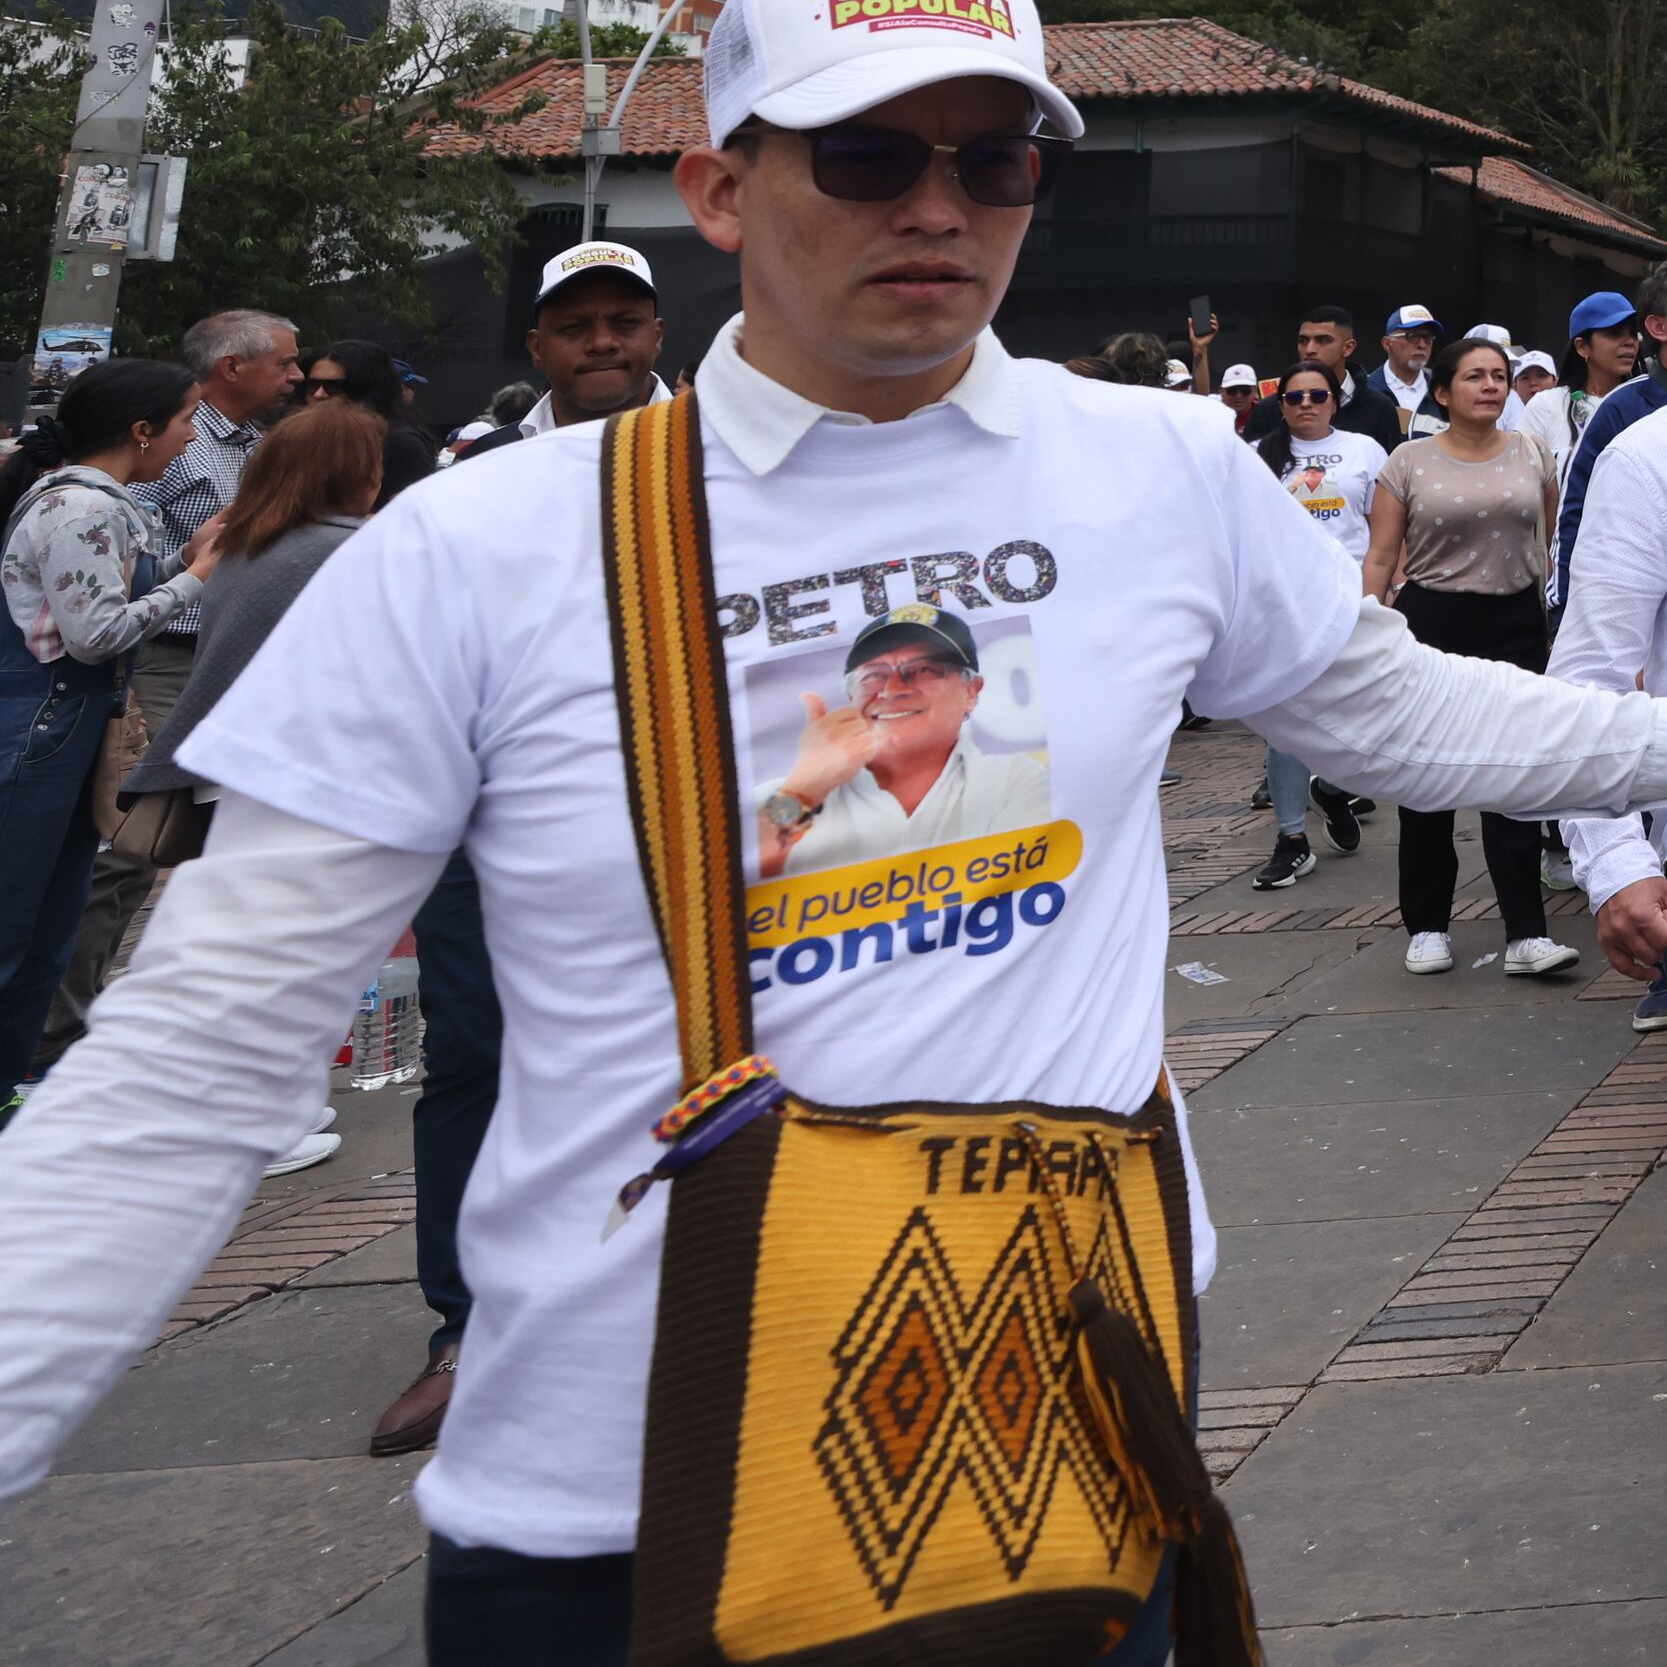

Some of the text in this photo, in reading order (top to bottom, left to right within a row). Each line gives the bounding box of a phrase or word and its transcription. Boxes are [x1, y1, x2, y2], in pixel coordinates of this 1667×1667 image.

[1294, 454, 1343, 466] ETRO
[716, 539, 1058, 648] PETRO
[750, 836, 1050, 934] el pueblo está
[749, 880, 1066, 995] contigo
